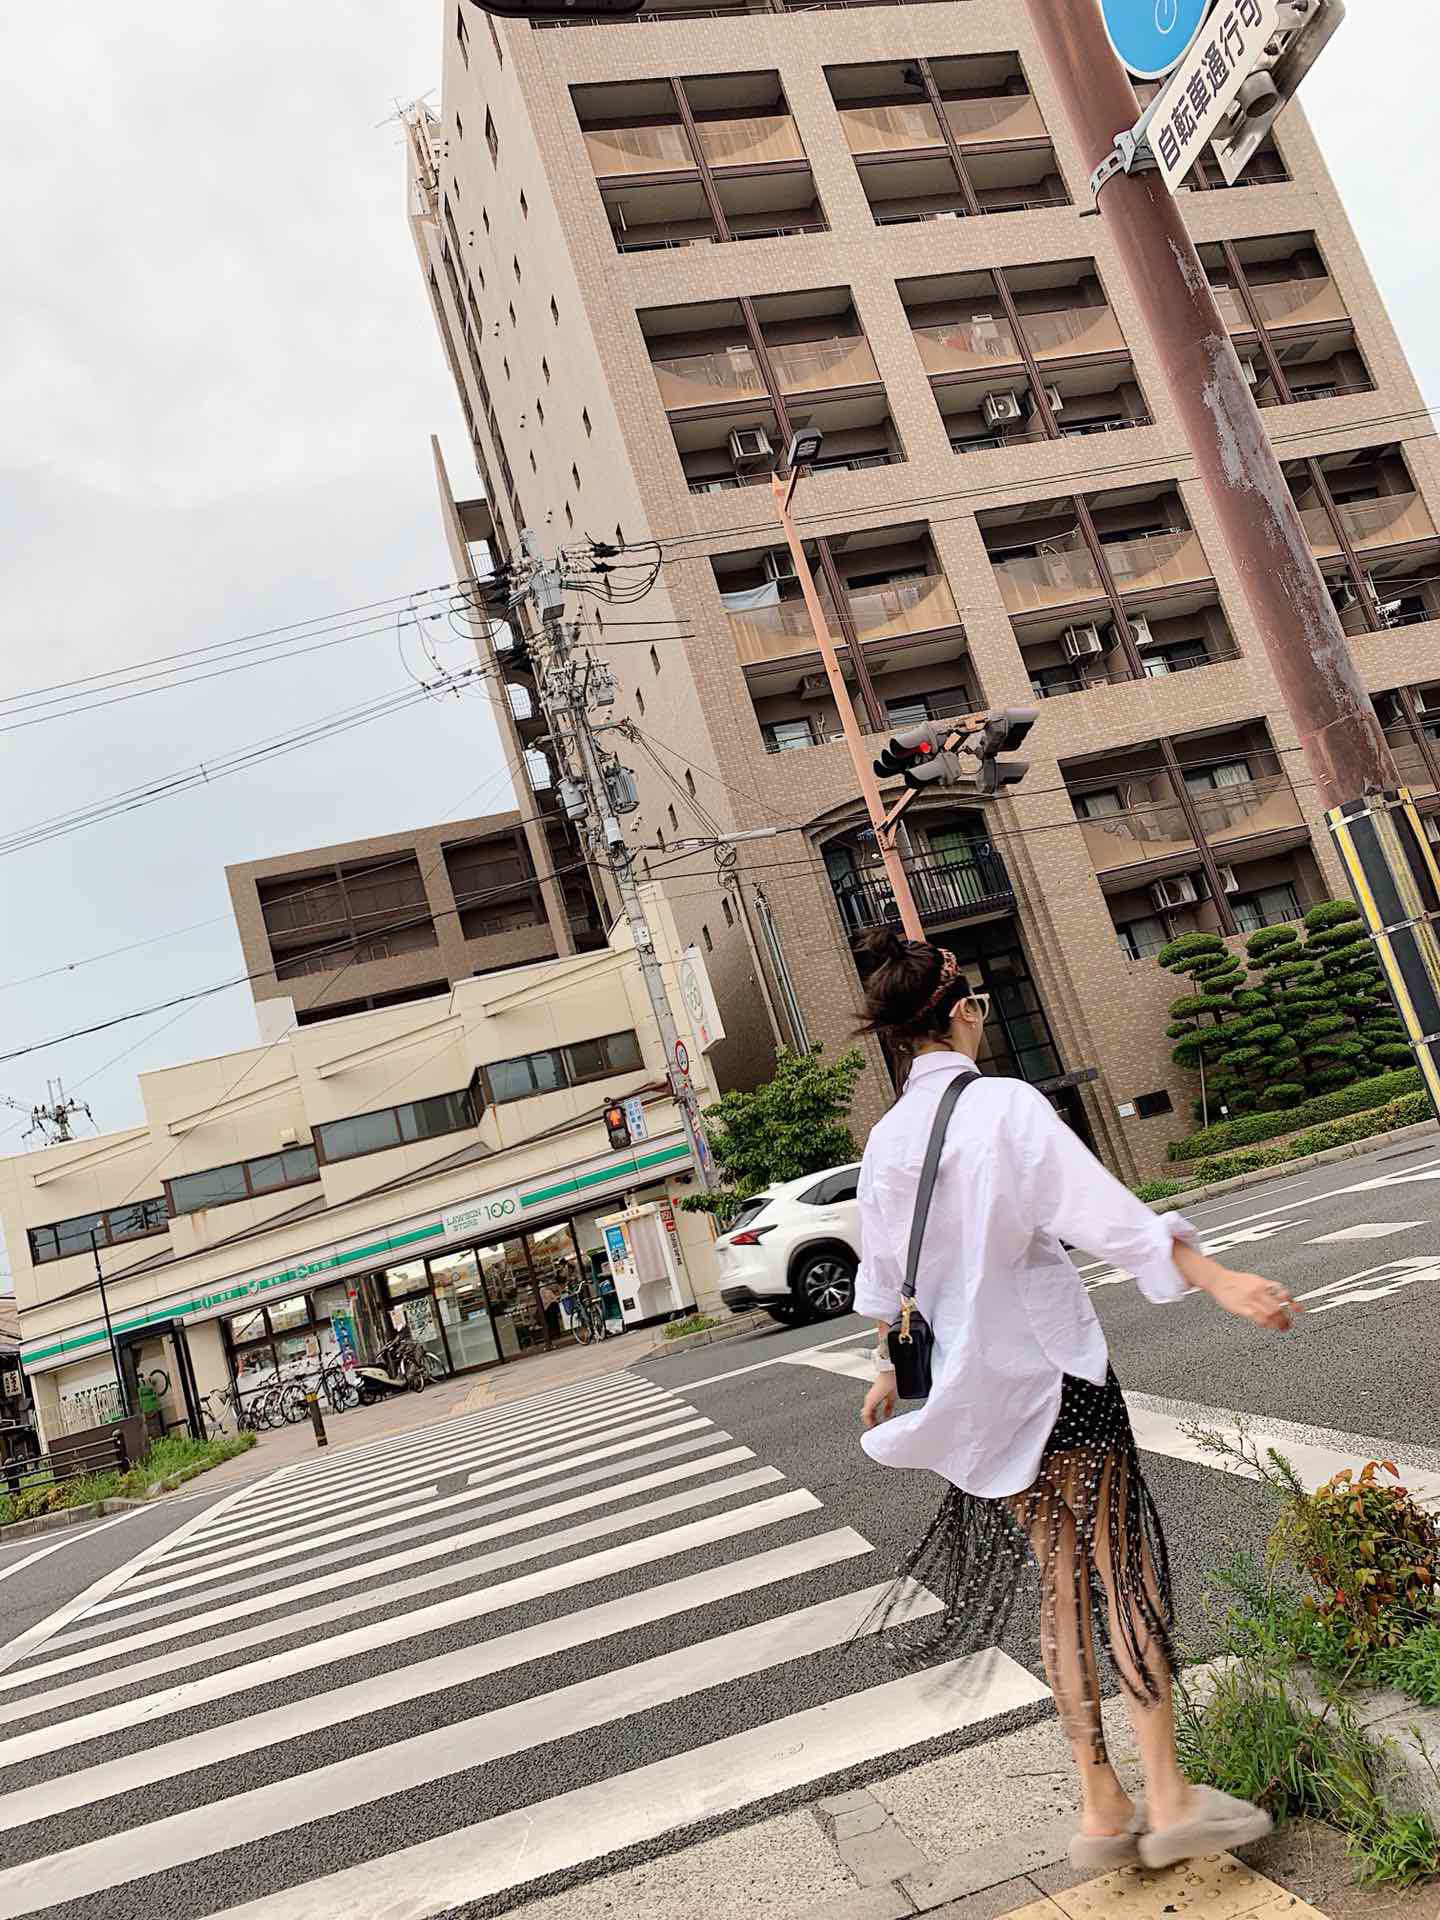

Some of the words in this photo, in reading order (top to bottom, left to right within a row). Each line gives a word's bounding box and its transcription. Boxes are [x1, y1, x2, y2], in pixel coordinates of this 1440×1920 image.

[1157, 0, 1263, 172] 自転車通行可
[484, 1199, 516, 1222] 100
